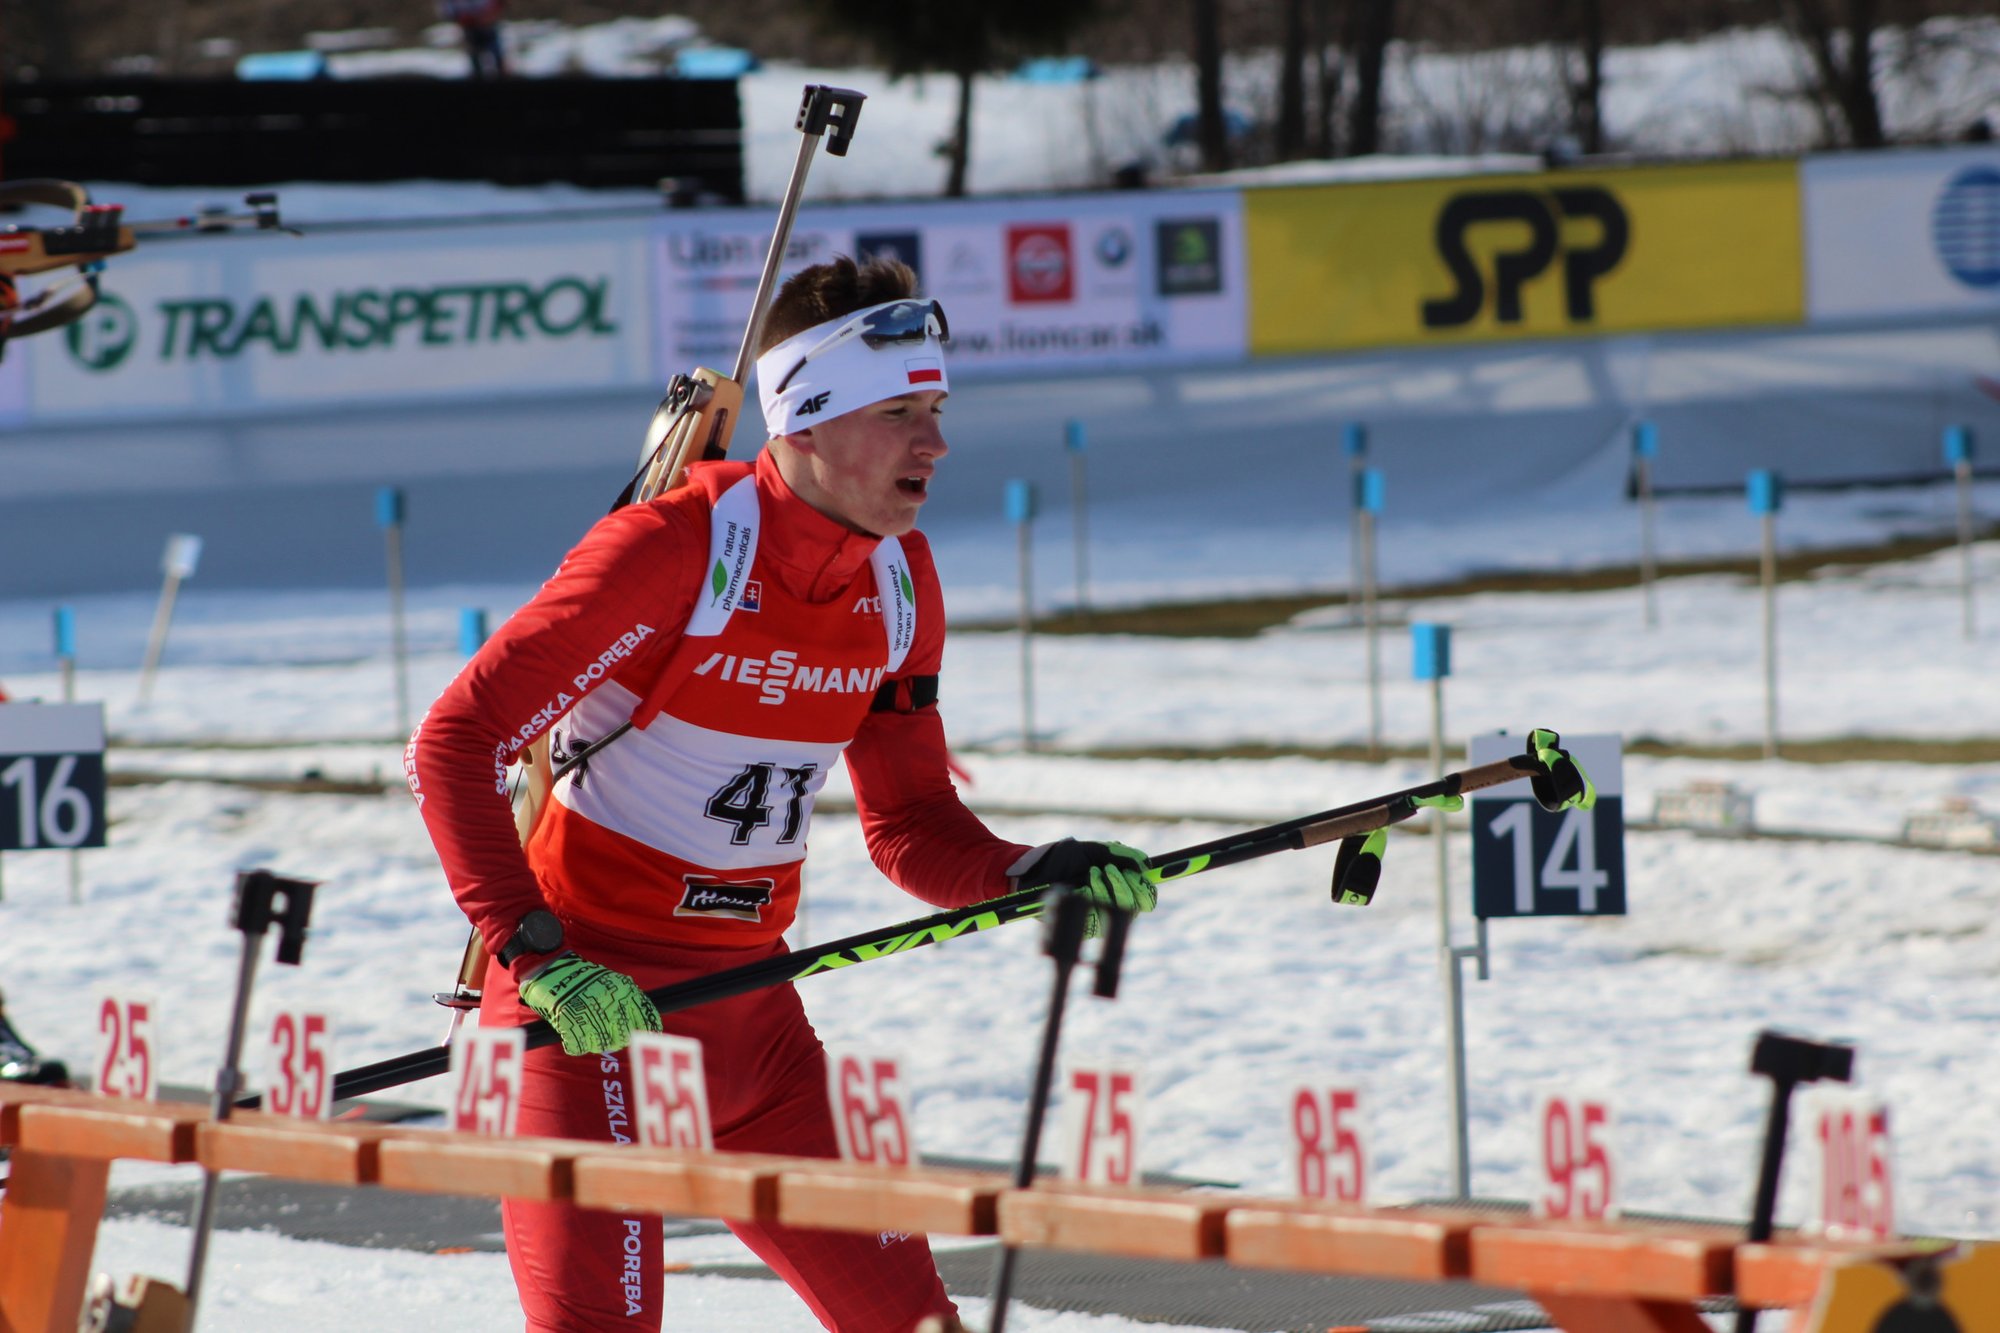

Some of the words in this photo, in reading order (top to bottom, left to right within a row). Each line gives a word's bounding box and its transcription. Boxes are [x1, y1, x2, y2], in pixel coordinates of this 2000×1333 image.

[1421, 184, 1632, 329] SPP
[157, 274, 620, 361] TRANSPETROL
[722, 527, 752, 612] pharmaceuticals
[724, 521, 738, 558] natural
[888, 564, 904, 652] pharmaceuticals
[902, 612, 912, 649] natural
[509, 691, 574, 752] ARSKA
[572, 623, 656, 692] PORĘBA
[1, 755, 93, 848] 16
[703, 761, 818, 845] 41
[1489, 801, 1609, 913] 14
[99, 996, 150, 1099] 25
[271, 1012, 326, 1119] 35
[456, 1040, 515, 1138] 45
[640, 1046, 701, 1150] 55
[602, 1079, 632, 1147] SZKLA
[838, 1056, 910, 1168] 65
[1070, 1070, 1135, 1184] 75
[1293, 1086, 1364, 1201] 85
[1543, 1096, 1612, 1221] 95
[1818, 1106, 1894, 1238] 105
[619, 1219, 642, 1317] PORĘBA
